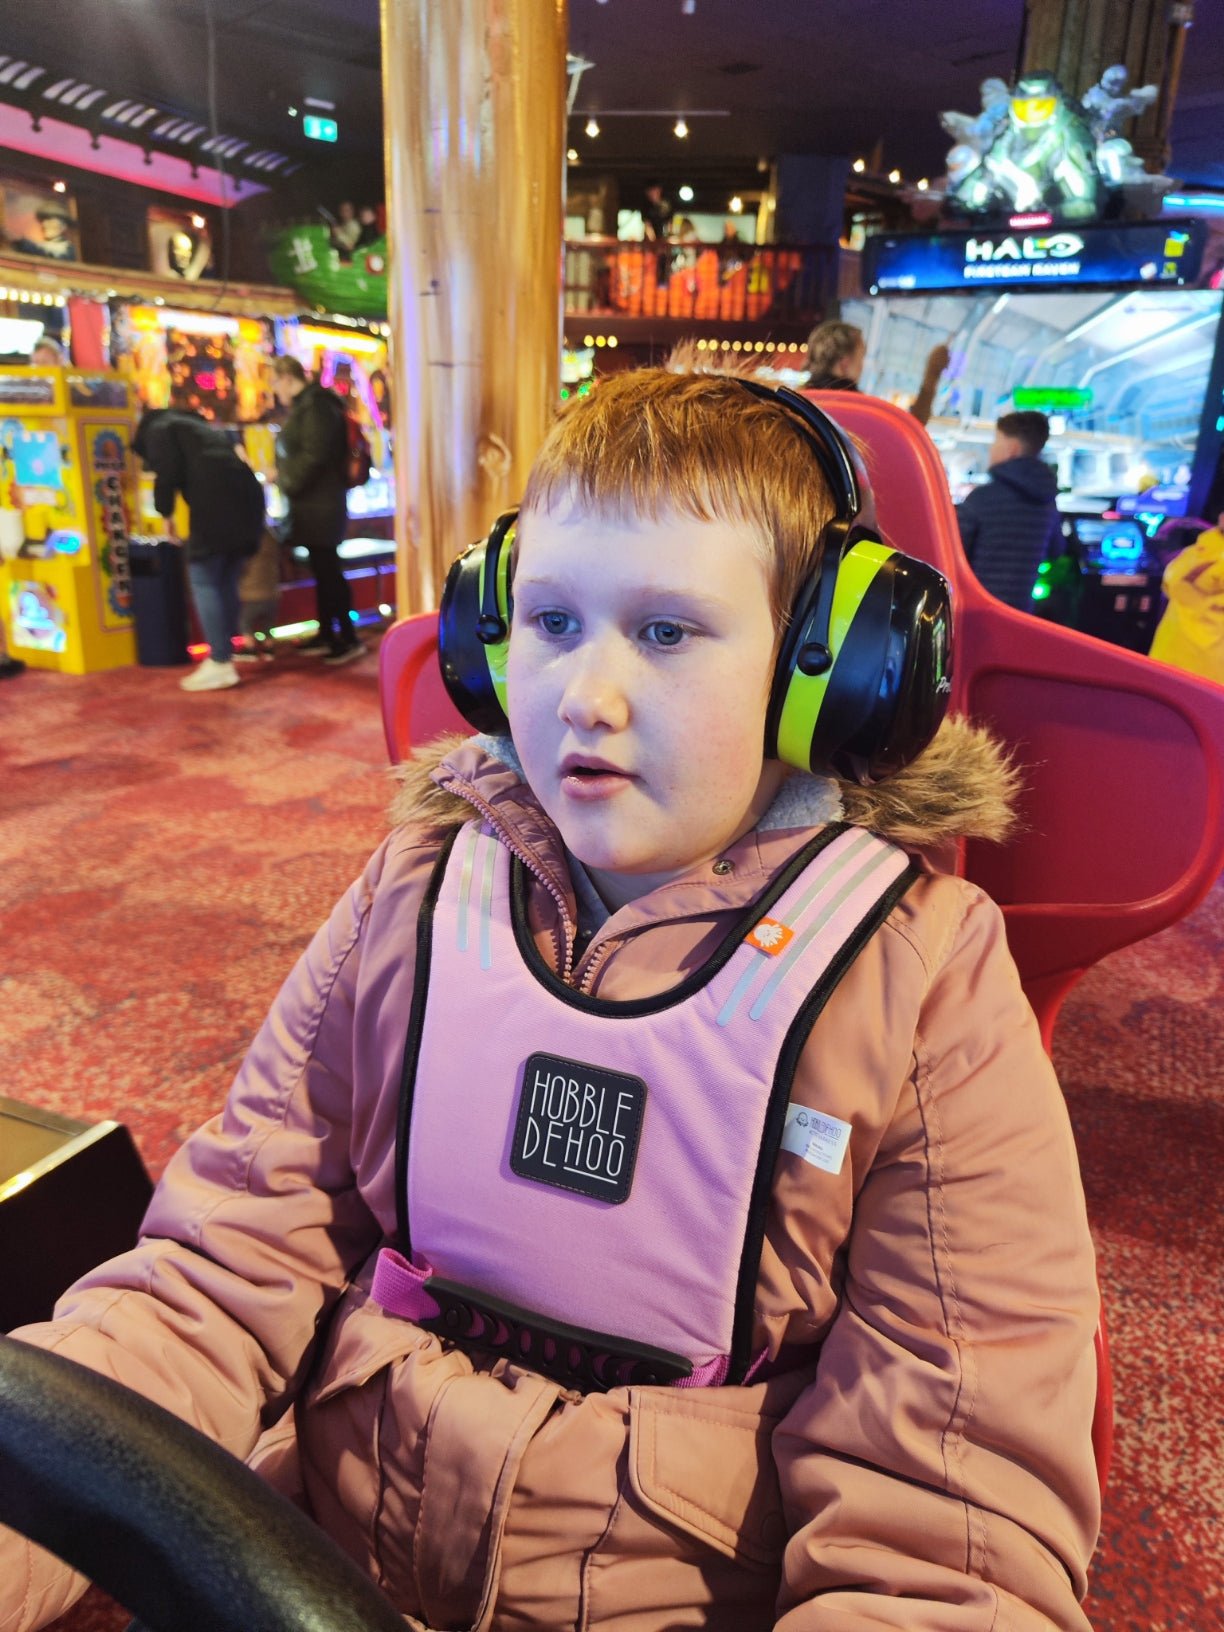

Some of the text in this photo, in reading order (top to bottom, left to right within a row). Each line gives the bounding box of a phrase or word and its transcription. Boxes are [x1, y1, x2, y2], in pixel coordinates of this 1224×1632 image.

[965, 233, 1084, 262] HALO
[530, 1070, 633, 1139] HOBBLE
[522, 1116, 624, 1177] DEHOO
